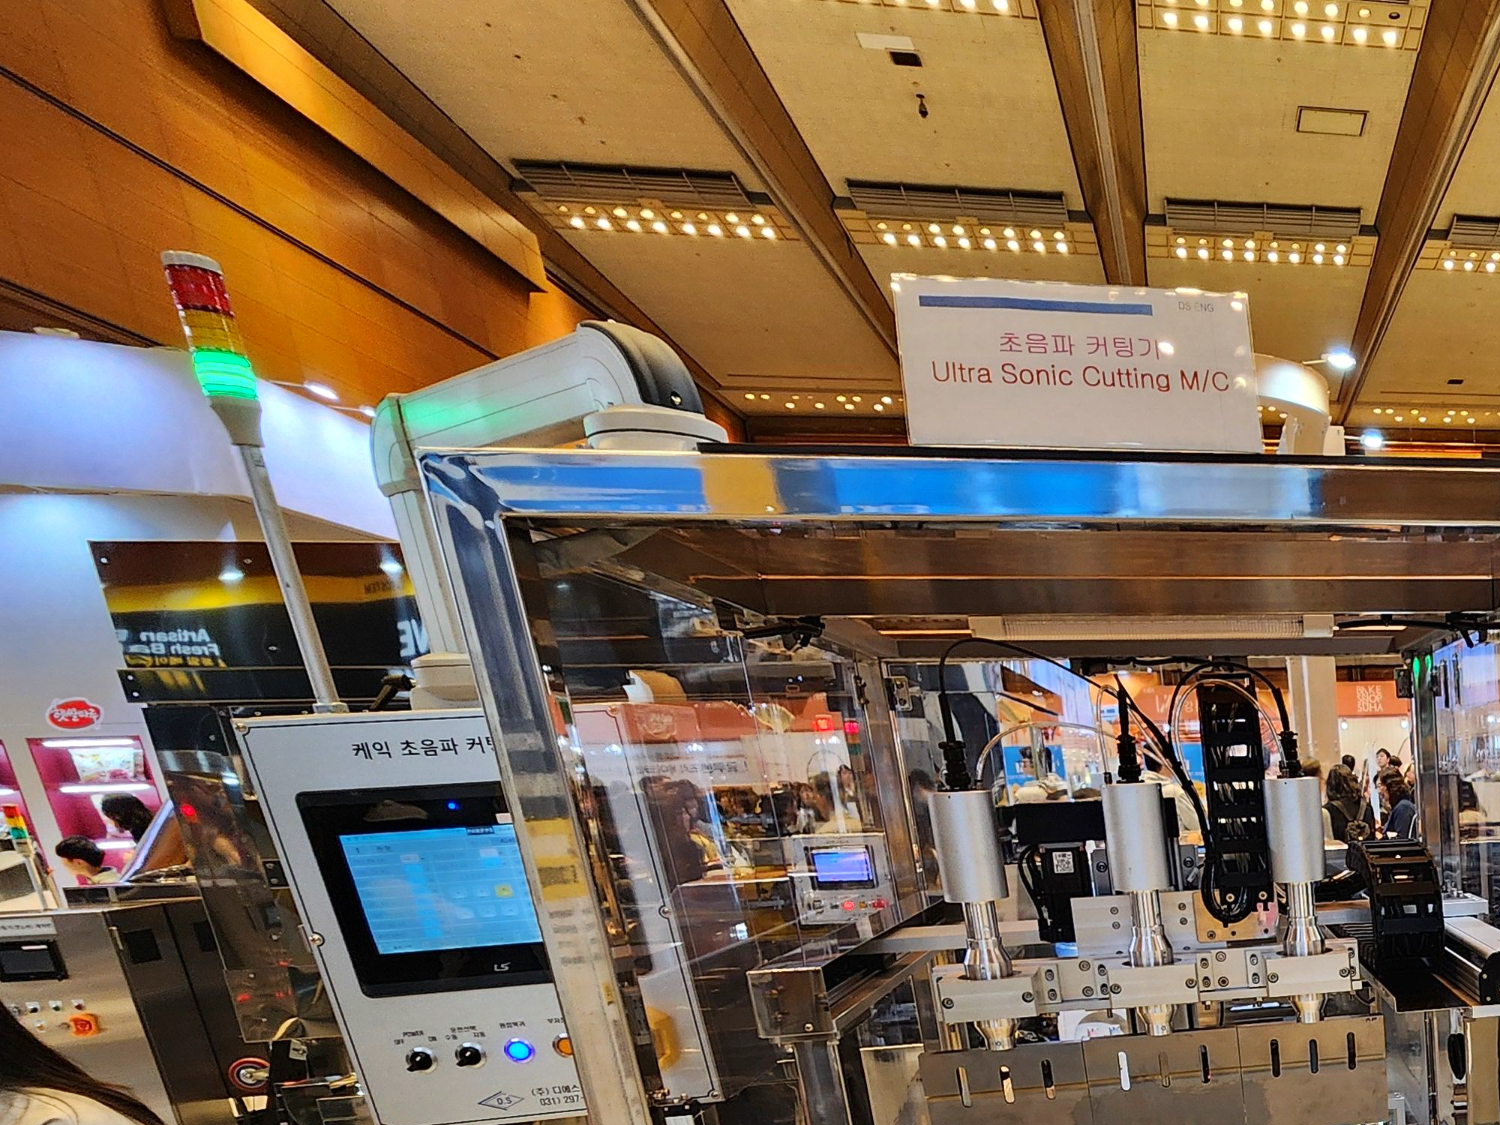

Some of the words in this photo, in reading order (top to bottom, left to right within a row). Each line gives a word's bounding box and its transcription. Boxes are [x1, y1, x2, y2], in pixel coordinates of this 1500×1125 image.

[1178, 301, 1191, 311] DS
[1194, 302, 1215, 313] ENG
[999, 332, 1075, 356] 초음파
[1086, 336, 1160, 360] 커팅기
[931, 360, 993, 384] Ultra
[1001, 362, 1073, 387] Sonic
[1082, 365, 1171, 392] Cutting
[1180, 369, 1230, 393] M/C
[351, 741, 392, 760] 케익
[400, 737, 459, 757] 초음파
[531, 1087, 550, 1097] (주)
[540, 1097, 561, 1107] 031)
